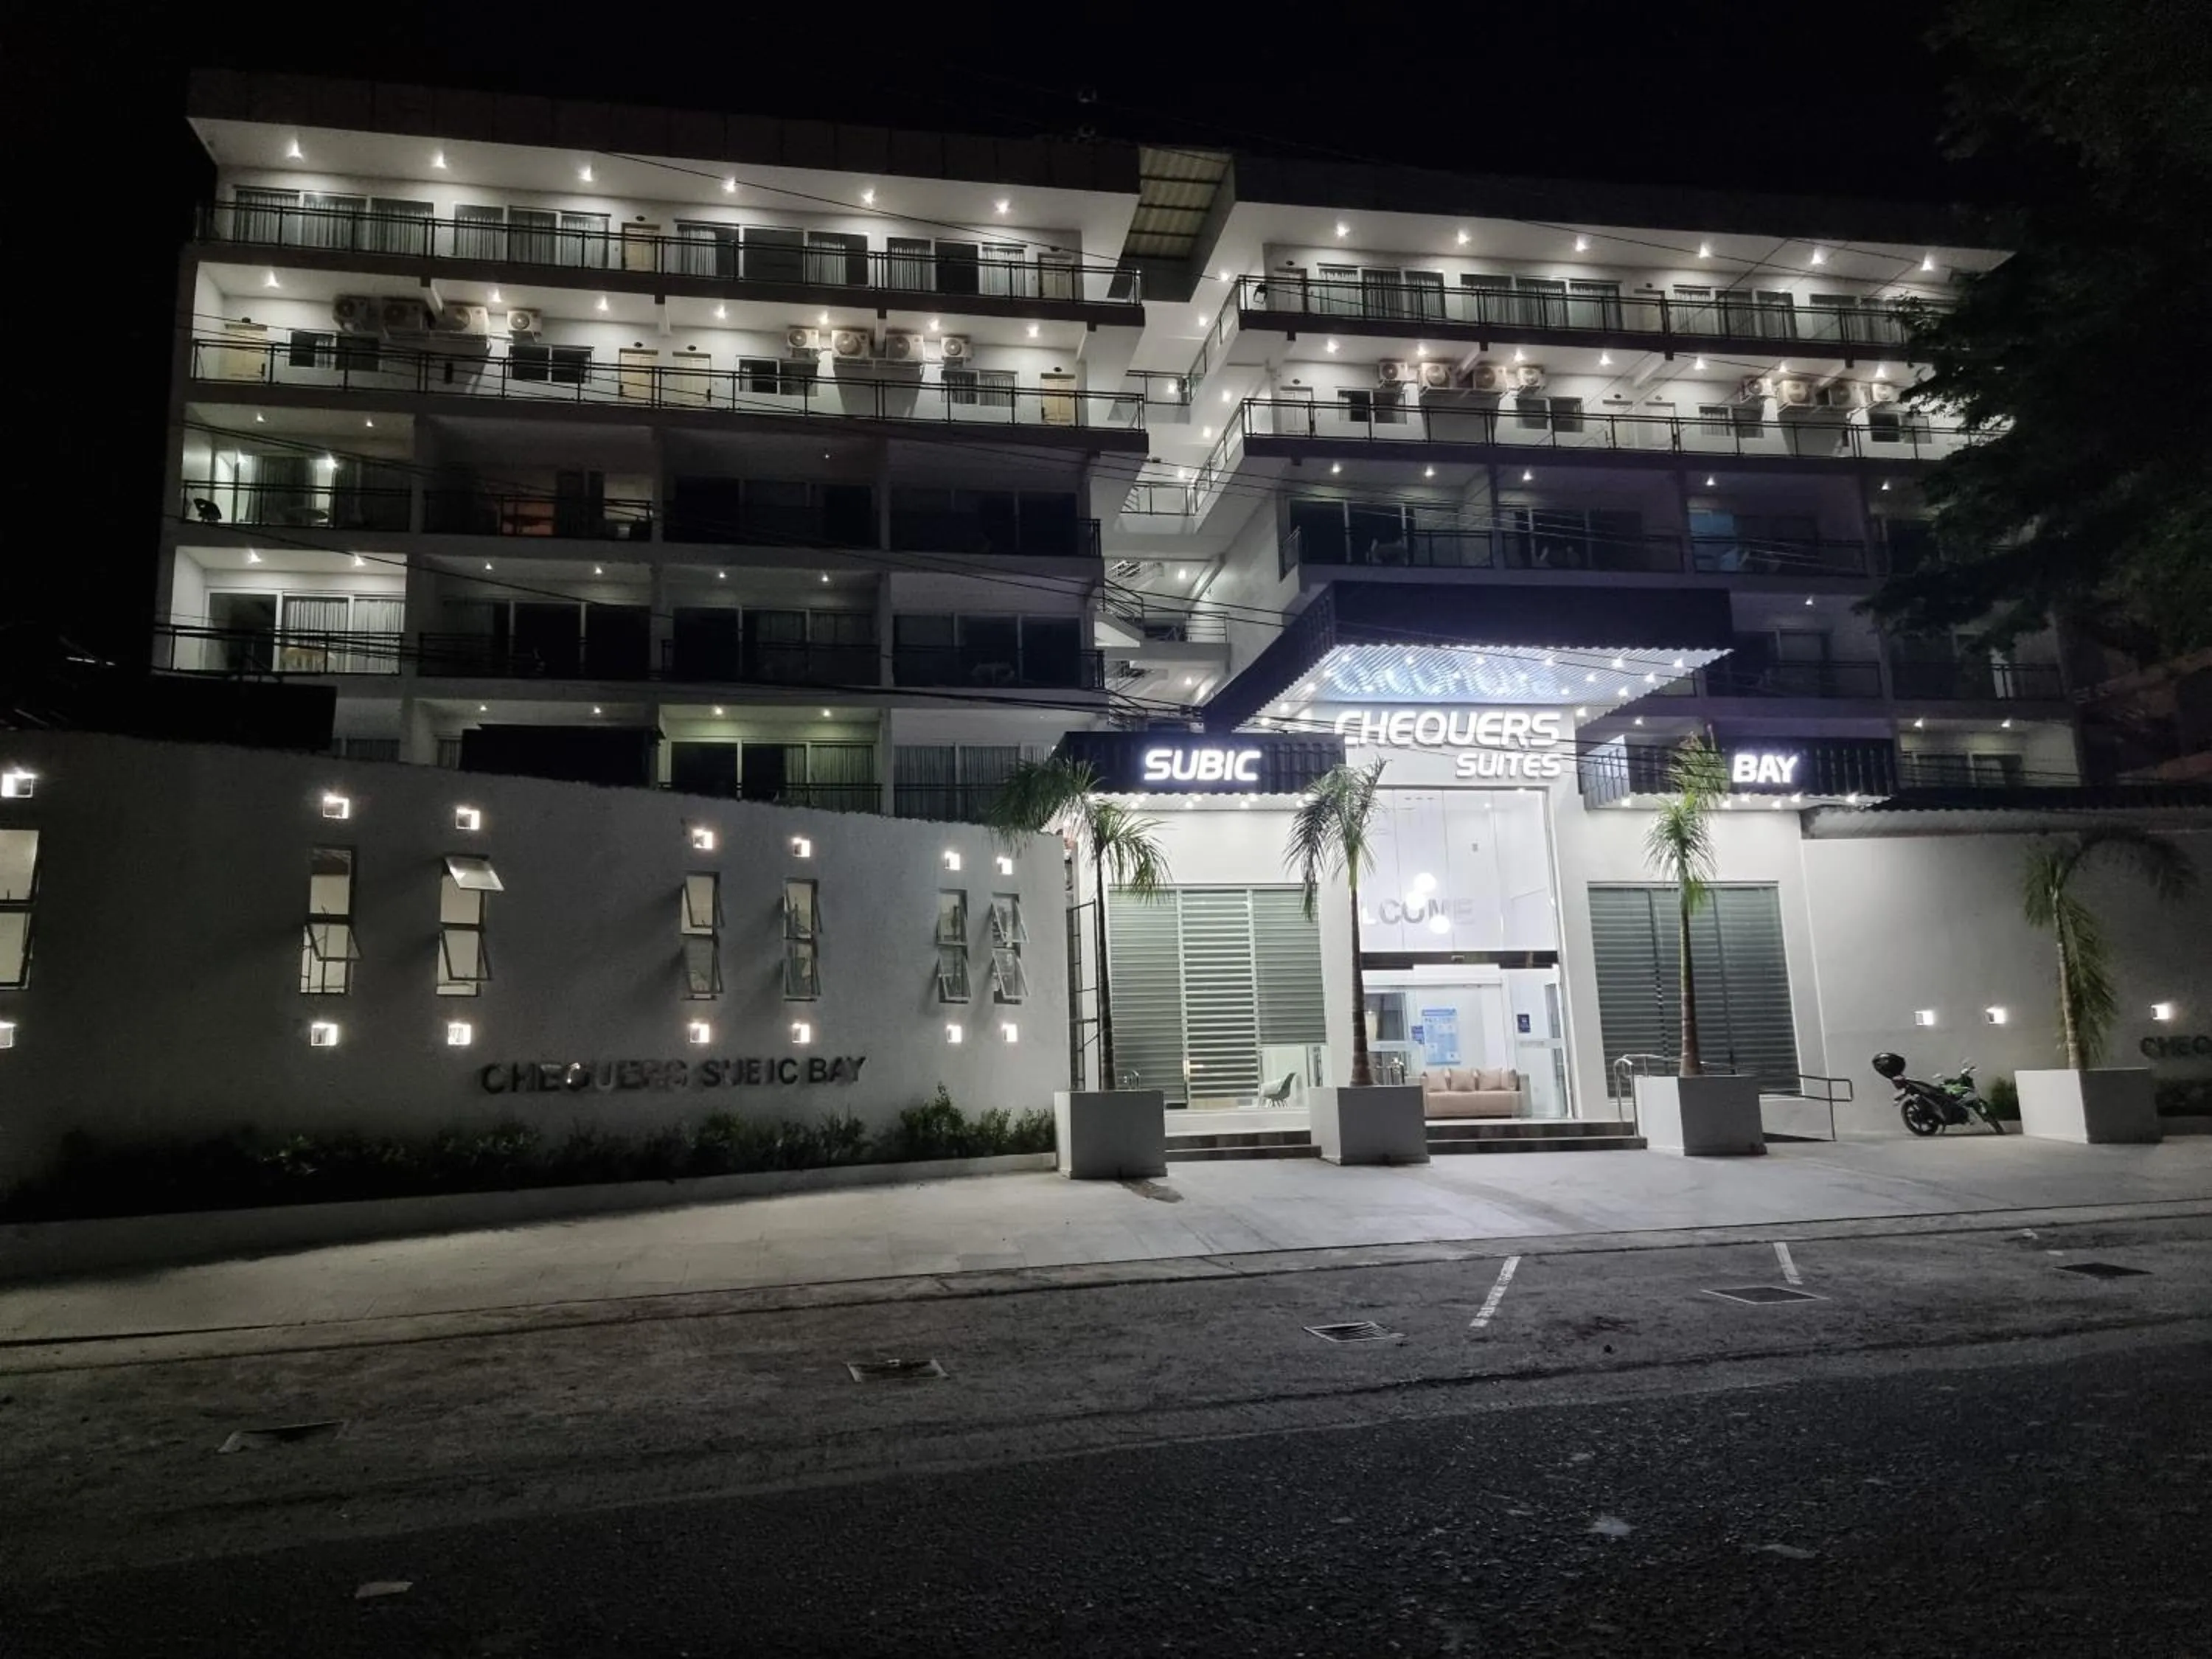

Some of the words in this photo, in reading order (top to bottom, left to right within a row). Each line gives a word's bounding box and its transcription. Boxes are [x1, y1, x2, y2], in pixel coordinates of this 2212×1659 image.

[1334, 710, 1561, 747] CHEQUERS
[1144, 748, 1262, 782] SUBIC
[1455, 753, 1561, 779] SUITES
[1733, 754, 1798, 783] BAY
[808, 1056, 866, 1084] BAY
